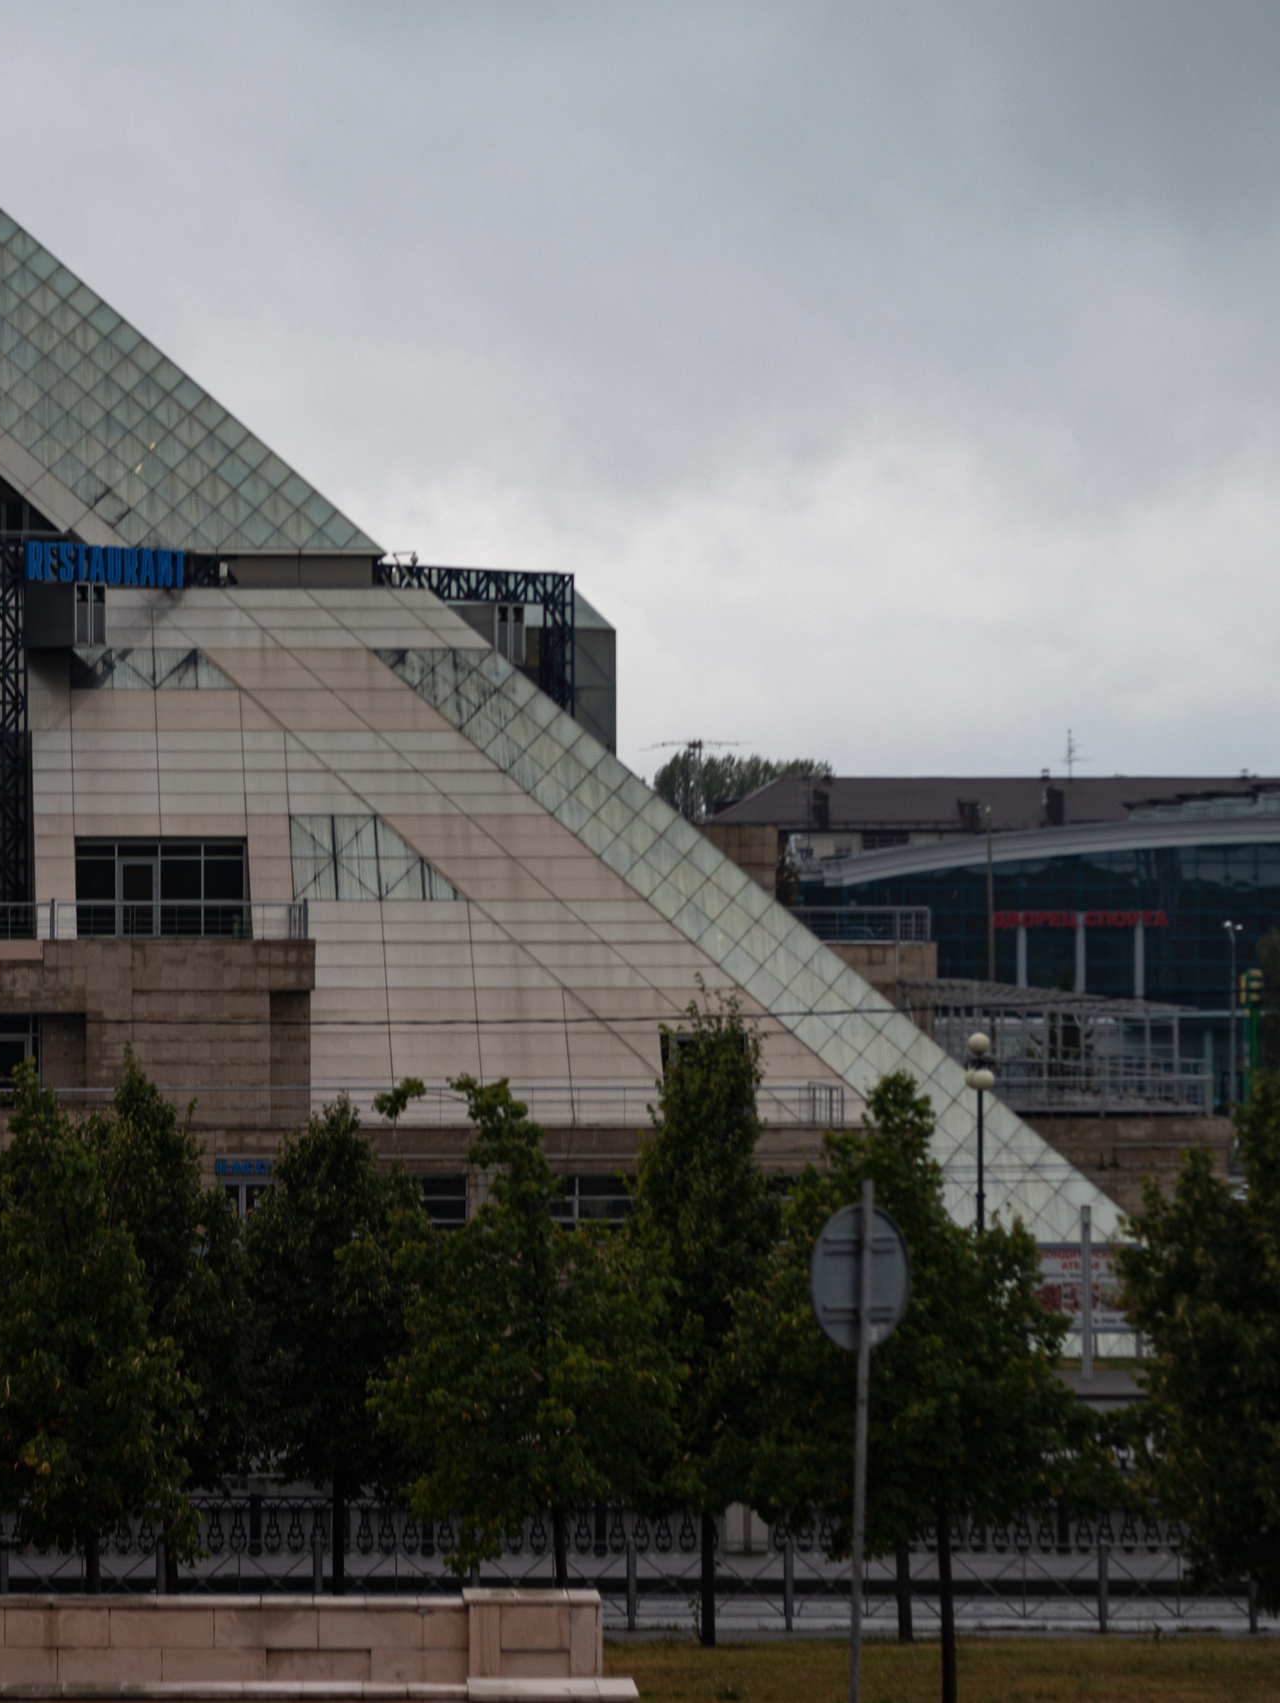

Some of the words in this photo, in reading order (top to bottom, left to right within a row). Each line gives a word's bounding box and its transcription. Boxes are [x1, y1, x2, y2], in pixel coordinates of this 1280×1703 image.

[25, 540, 186, 588] RESTAURANT
[993, 909, 1078, 930] ДВОРЕЦ
[1084, 909, 1169, 928] СПОРТА
